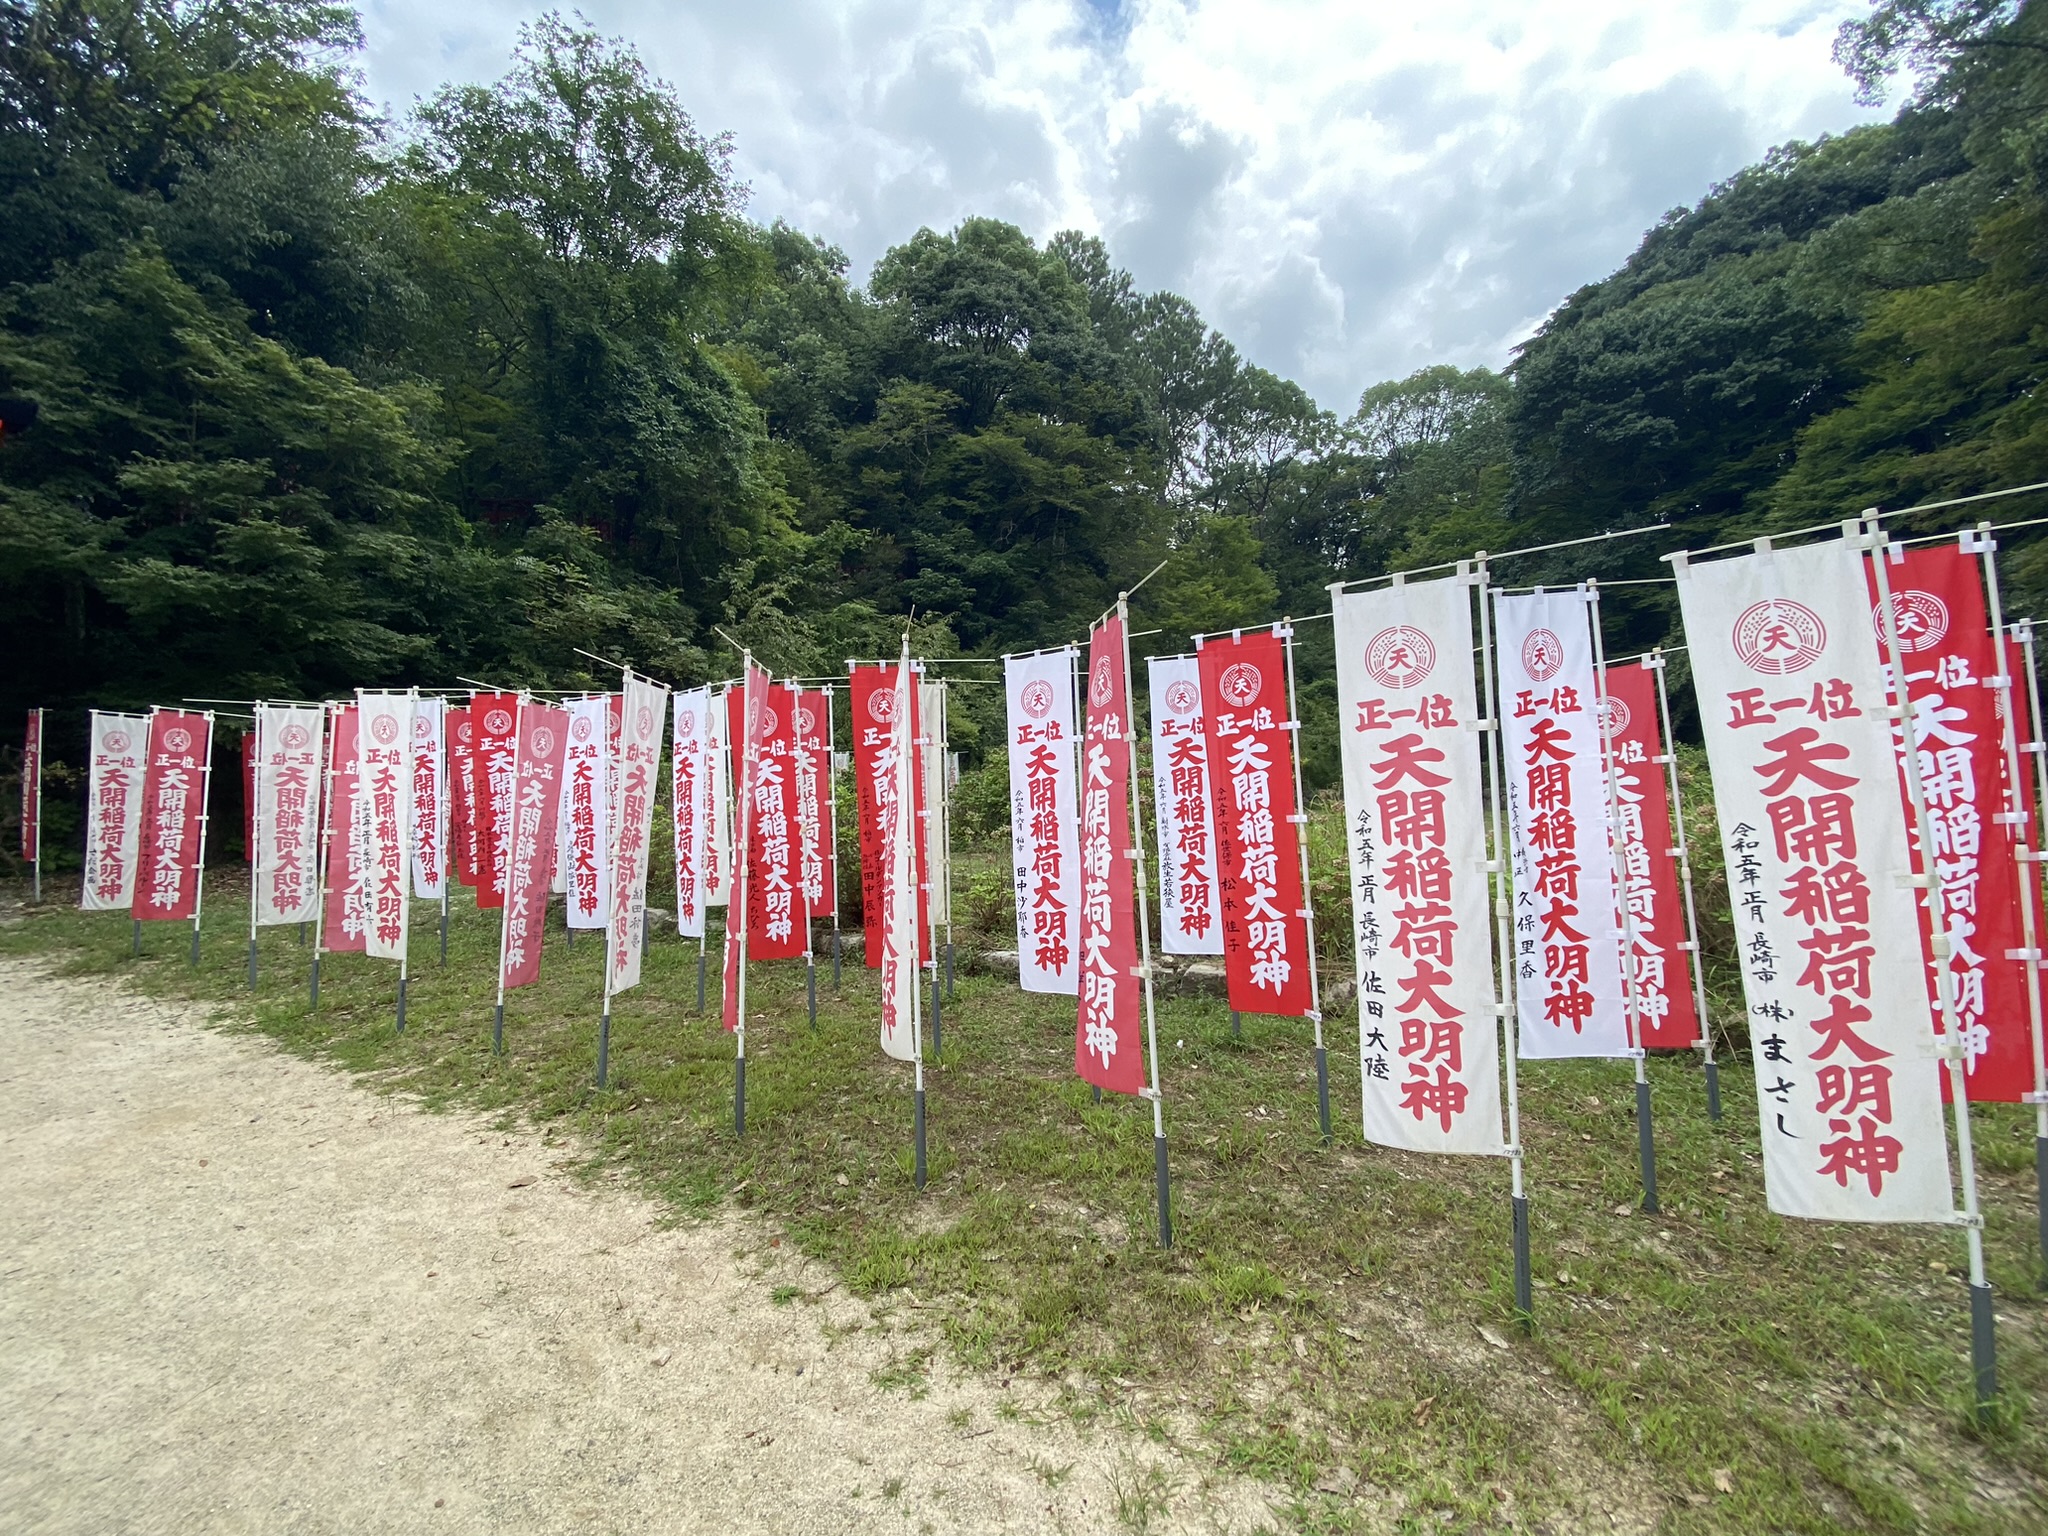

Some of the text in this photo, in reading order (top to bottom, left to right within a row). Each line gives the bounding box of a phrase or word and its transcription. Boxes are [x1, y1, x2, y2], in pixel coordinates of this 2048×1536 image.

[95, 755, 136, 768] 正一位
[155, 754, 196, 769] 正一位
[366, 748, 401, 766] 正一位
[480, 737, 517, 751] 正一位
[569, 744, 598, 760] 正一位
[674, 742, 699, 756] 正一位
[1017, 724, 1062, 745] 正一位
[1160, 718, 1204, 737] 正一位
[1215, 706, 1275, 737] 正一位
[1354, 692, 1460, 732] 正一位
[1514, 685, 1582, 720] 正一位
[1727, 678, 1863, 728] 正一位
[97, 769, 130, 901] 天開稲荷大明神
[150, 769, 190, 910] 天開稲荷大明神
[372, 766, 402, 949] 天開稲荷大明神
[413, 753, 438, 889] 天開稲荷大明神
[572, 760, 598, 918] 天開稲荷大明神
[674, 756, 696, 926] 天開稲荷大明神
[755, 757, 793, 946] 天開稲荷大明神
[1026, 743, 1070, 977] 天開稲荷大明神
[1168, 736, 1212, 940] 天開稲荷大明神
[1226, 735, 1294, 997] 天開稲荷大明神
[1524, 718, 1594, 1036] 天開稲荷大明神
[1731, 820, 1768, 924] 令和五年正月
[1891, 693, 1990, 1076] 天開稲荷大明神
[1083, 743, 1119, 1070] 天開稲荷大明神
[1220, 876, 1241, 953] 松本佳子
[1355, 808, 1391, 1082] 令和五年正月 長崎市 佐田大陸
[1368, 733, 1468, 1134] 天開稲荷大明神
[1516, 889, 1538, 980] 久保里香
[1600, 765, 1670, 1031] 天開稲荷大明神
[1747, 931, 1781, 985] 長崎市
[1755, 727, 1902, 1198] 天開稲荷大明神
